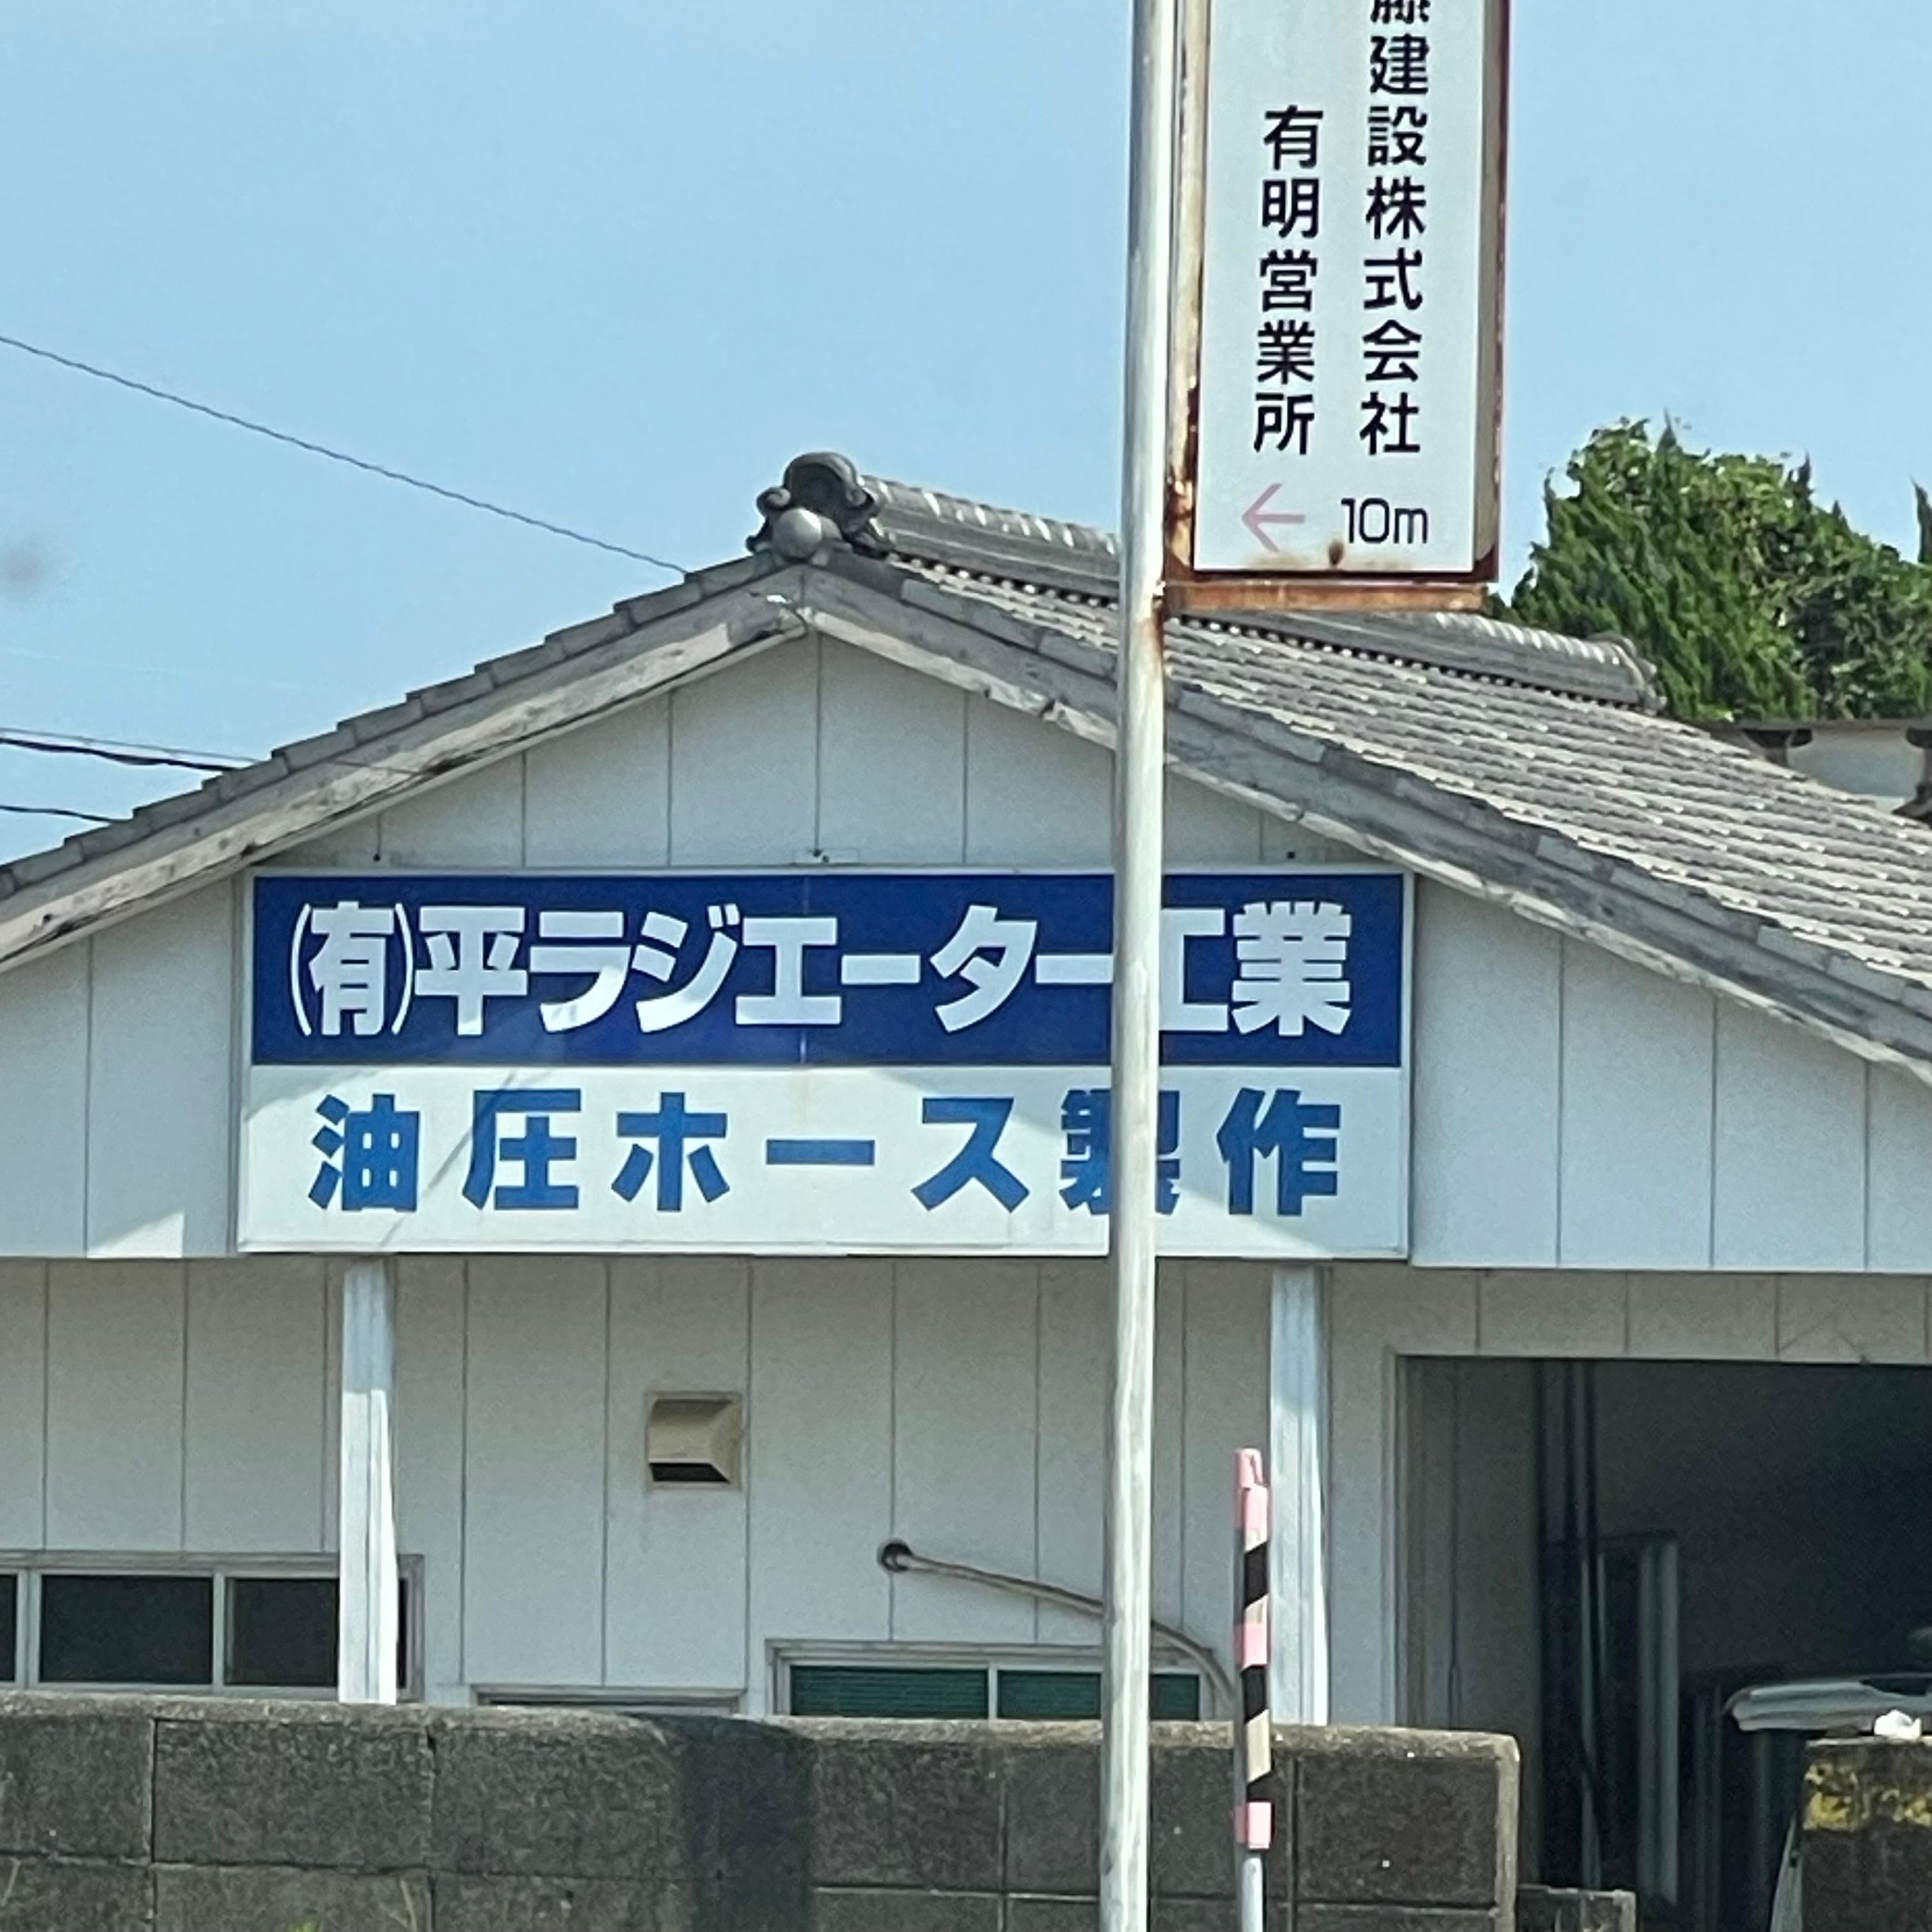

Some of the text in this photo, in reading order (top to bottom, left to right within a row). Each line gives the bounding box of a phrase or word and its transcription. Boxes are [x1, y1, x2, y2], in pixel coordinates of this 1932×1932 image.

[1254, 105, 1324, 456] 有明営業所
[1340, 498, 1429, 545] 10m
[308, 1088, 1341, 1215] 油圧ホース製作
